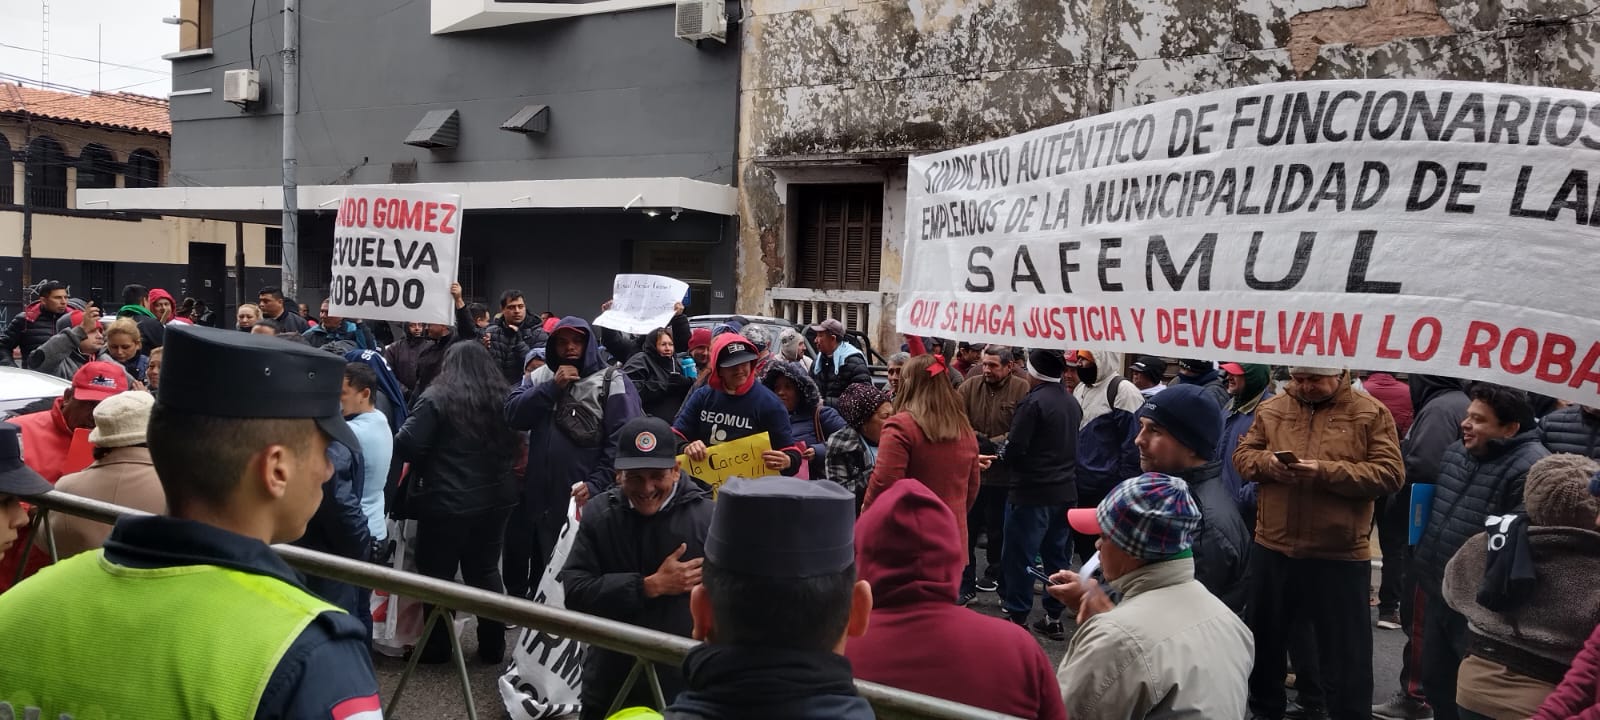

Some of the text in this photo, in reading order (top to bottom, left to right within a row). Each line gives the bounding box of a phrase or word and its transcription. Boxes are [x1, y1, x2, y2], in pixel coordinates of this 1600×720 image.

[923, 89, 1600, 193] SINDICATO AUTÉNTICO DE FUNCIONARIOS
[373, 198, 457, 234] GOMEZ
[921, 197, 1004, 240] EMPLEADOS
[1003, 194, 1039, 235] DE
[1040, 188, 1070, 231] LA
[1080, 160, 1390, 227] MUNICIPALIDAD
[1405, 160, 1488, 214] DE
[962, 302, 1016, 337] HAGA
[1022, 305, 1126, 342] JUSTICIA
[1130, 307, 1146, 343] Y
[1157, 308, 1364, 357] DEVUELVAN
[1376, 314, 1443, 361] LO
[700, 410, 753, 430] SEOMUL
[708, 441, 756, 471] Carcel
